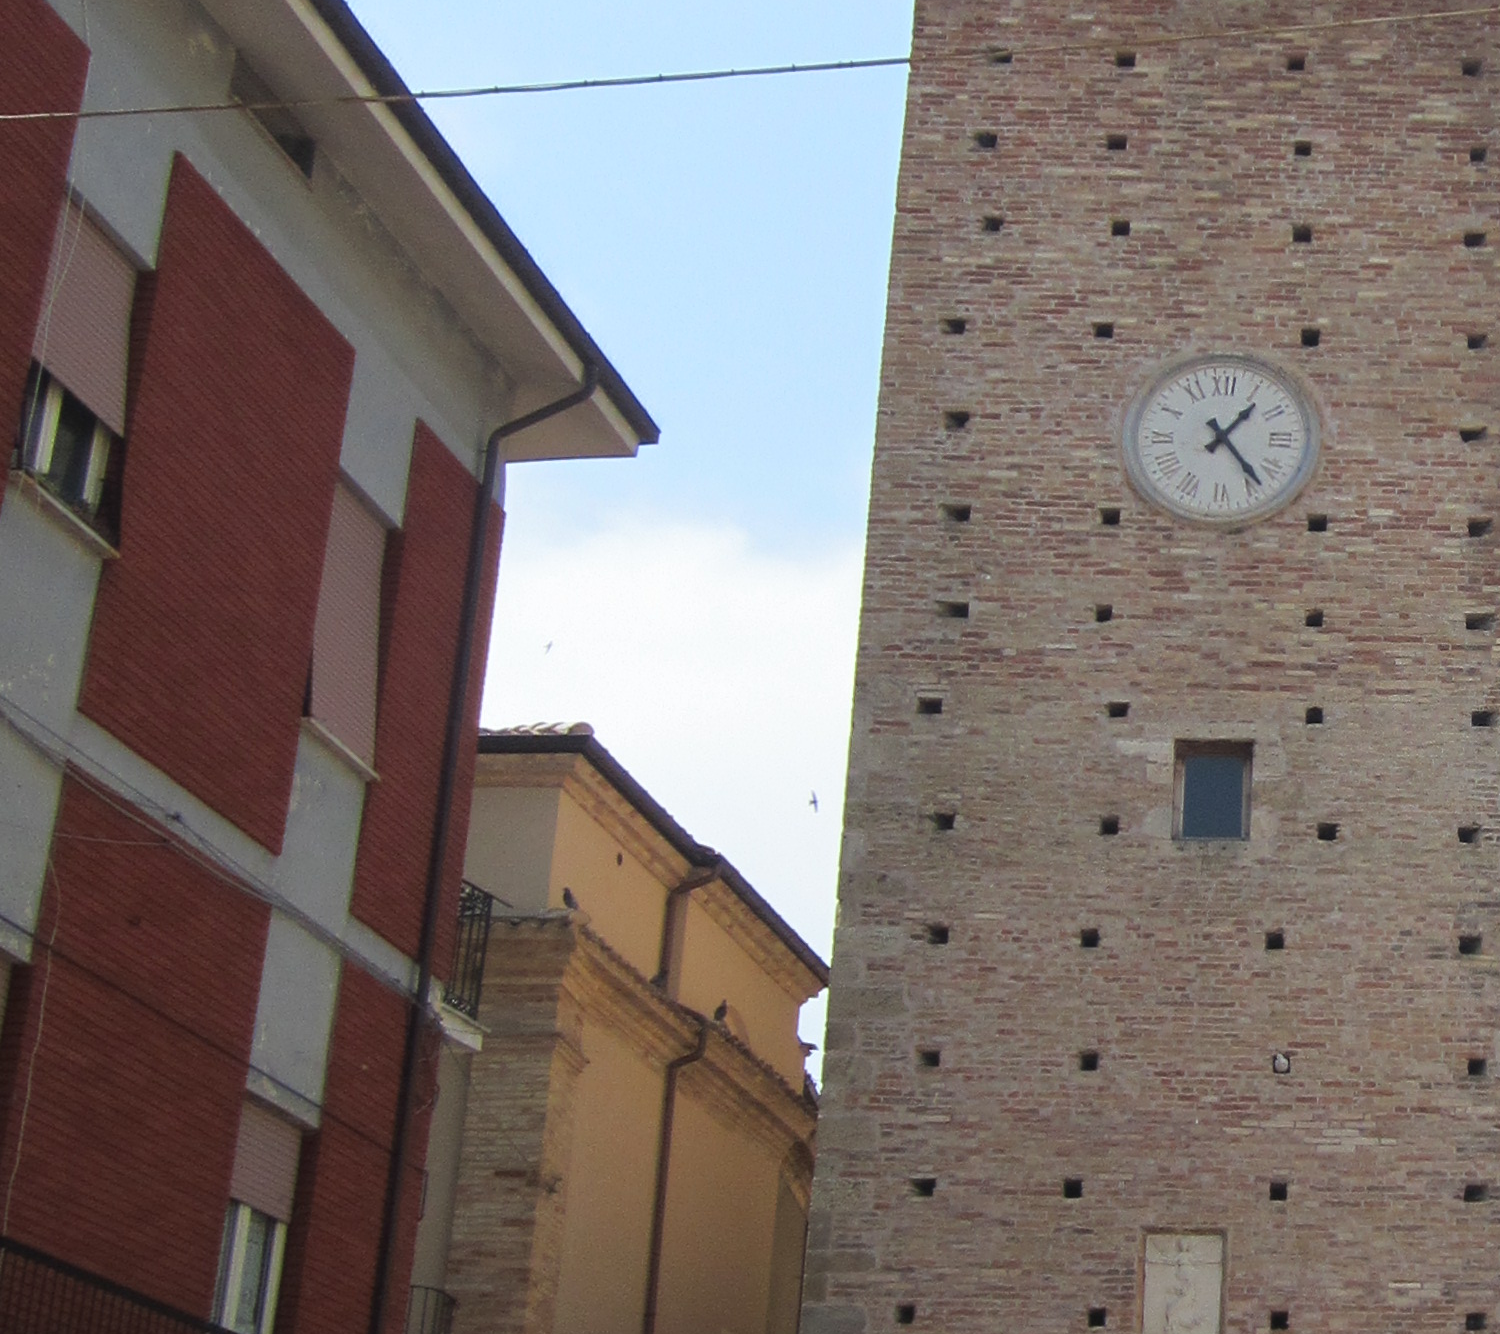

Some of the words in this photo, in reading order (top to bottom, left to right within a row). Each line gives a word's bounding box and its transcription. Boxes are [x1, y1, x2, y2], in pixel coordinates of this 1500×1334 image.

[1212, 376, 1236, 396] XII
[1161, 405, 1183, 420] X
[1262, 404, 1285, 421] II
[1269, 432, 1293, 448] III
